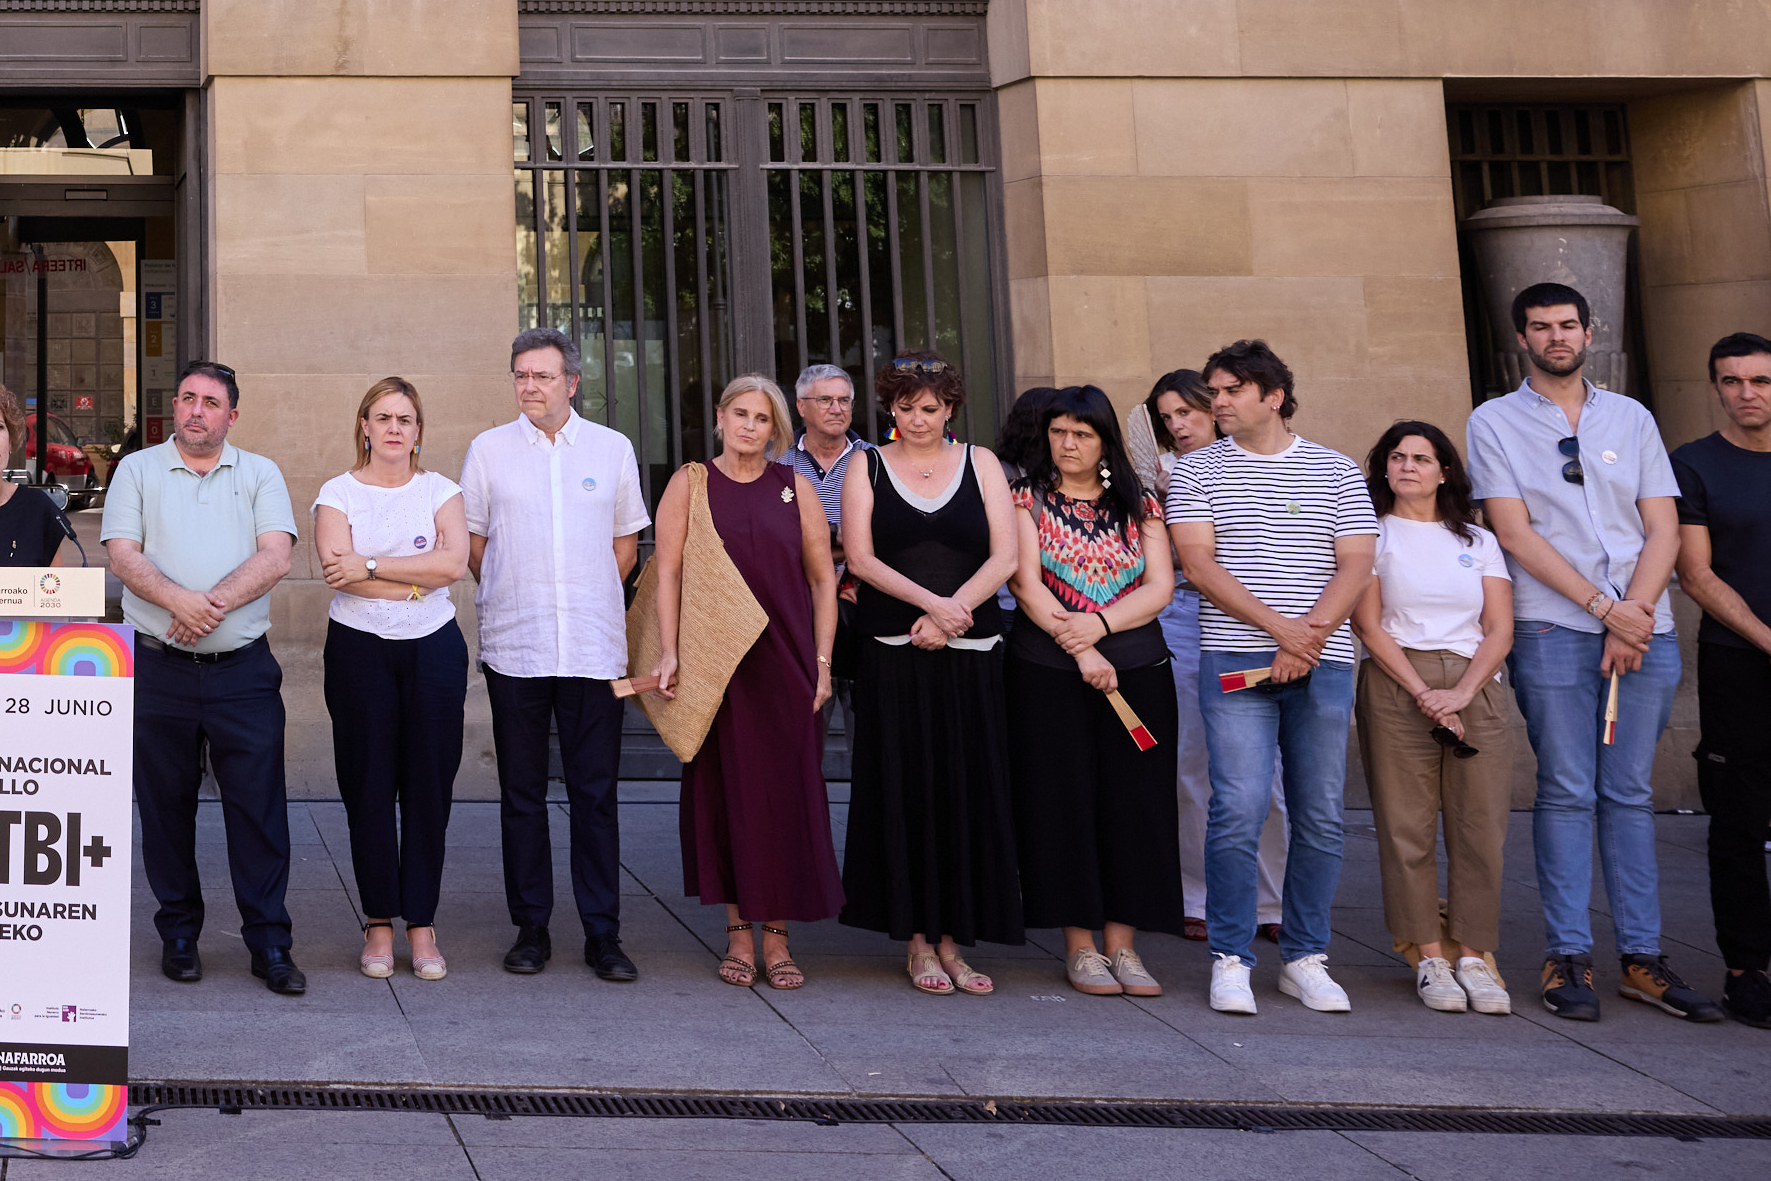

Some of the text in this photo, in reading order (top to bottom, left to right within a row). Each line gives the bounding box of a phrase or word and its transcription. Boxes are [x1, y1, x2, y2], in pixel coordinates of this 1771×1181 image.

[150, 300, 157, 310] 3
[5, 697, 30, 714] 28
[44, 698, 113, 716] JUNIO
